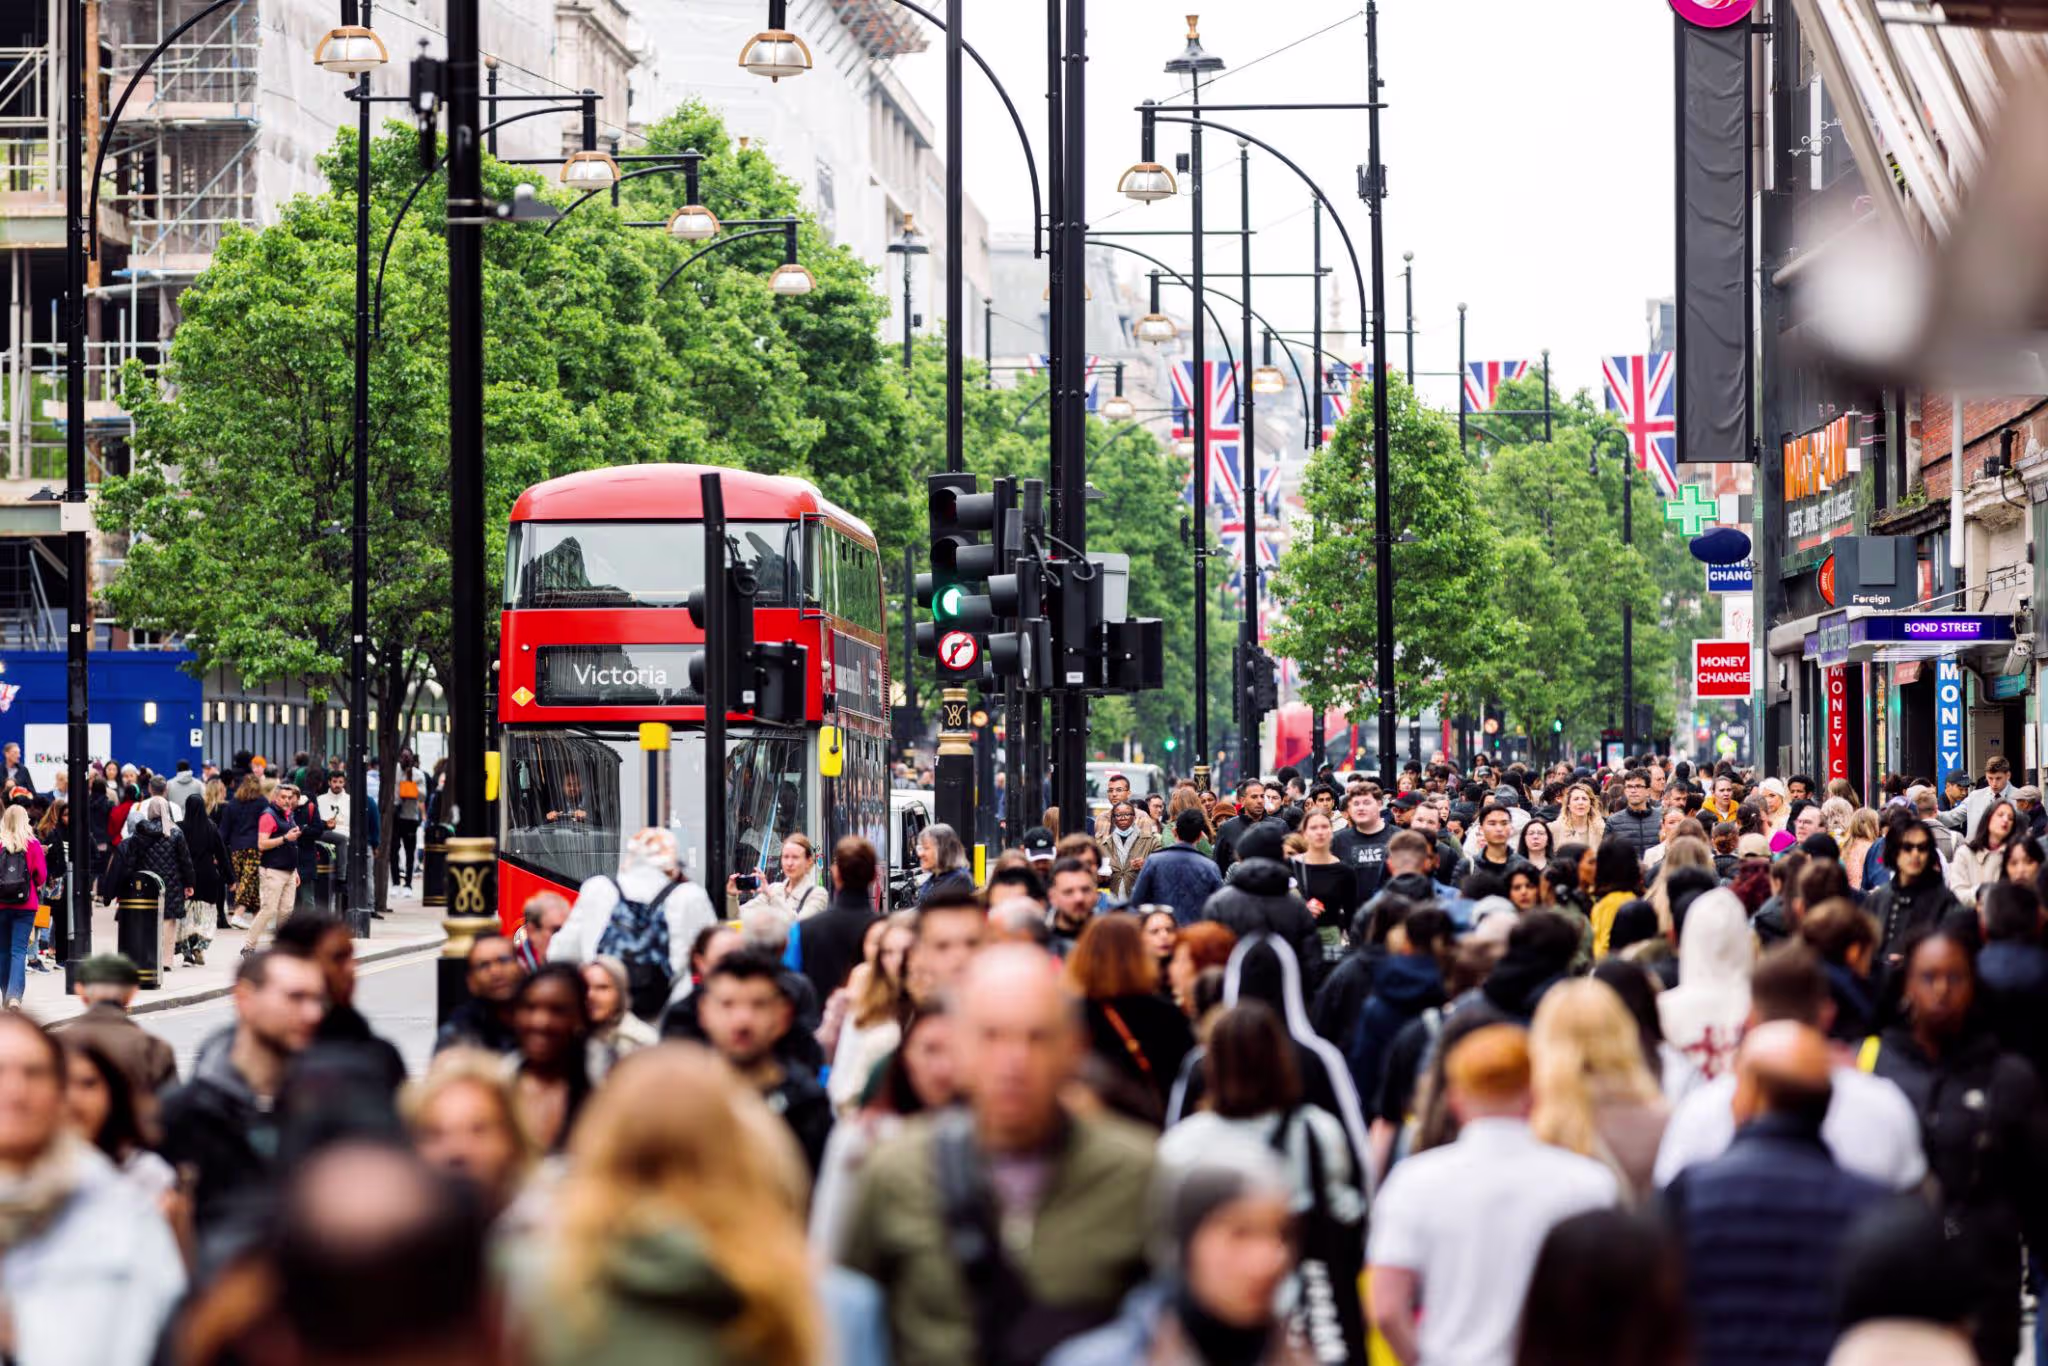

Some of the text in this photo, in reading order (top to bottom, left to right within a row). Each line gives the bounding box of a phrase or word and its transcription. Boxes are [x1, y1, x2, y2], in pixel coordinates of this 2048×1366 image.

[1710, 571, 1753, 581] CHANG
[1852, 594, 1891, 605] Foreign
[1904, 622, 1982, 633] BOND STREET
[1700, 656, 1746, 667] MONEY
[573, 663, 667, 685] Victoria
[1698, 672, 1752, 683] CHANGE
[1830, 665, 1844, 748] MONEY
[1940, 662, 1959, 769] MONEY
